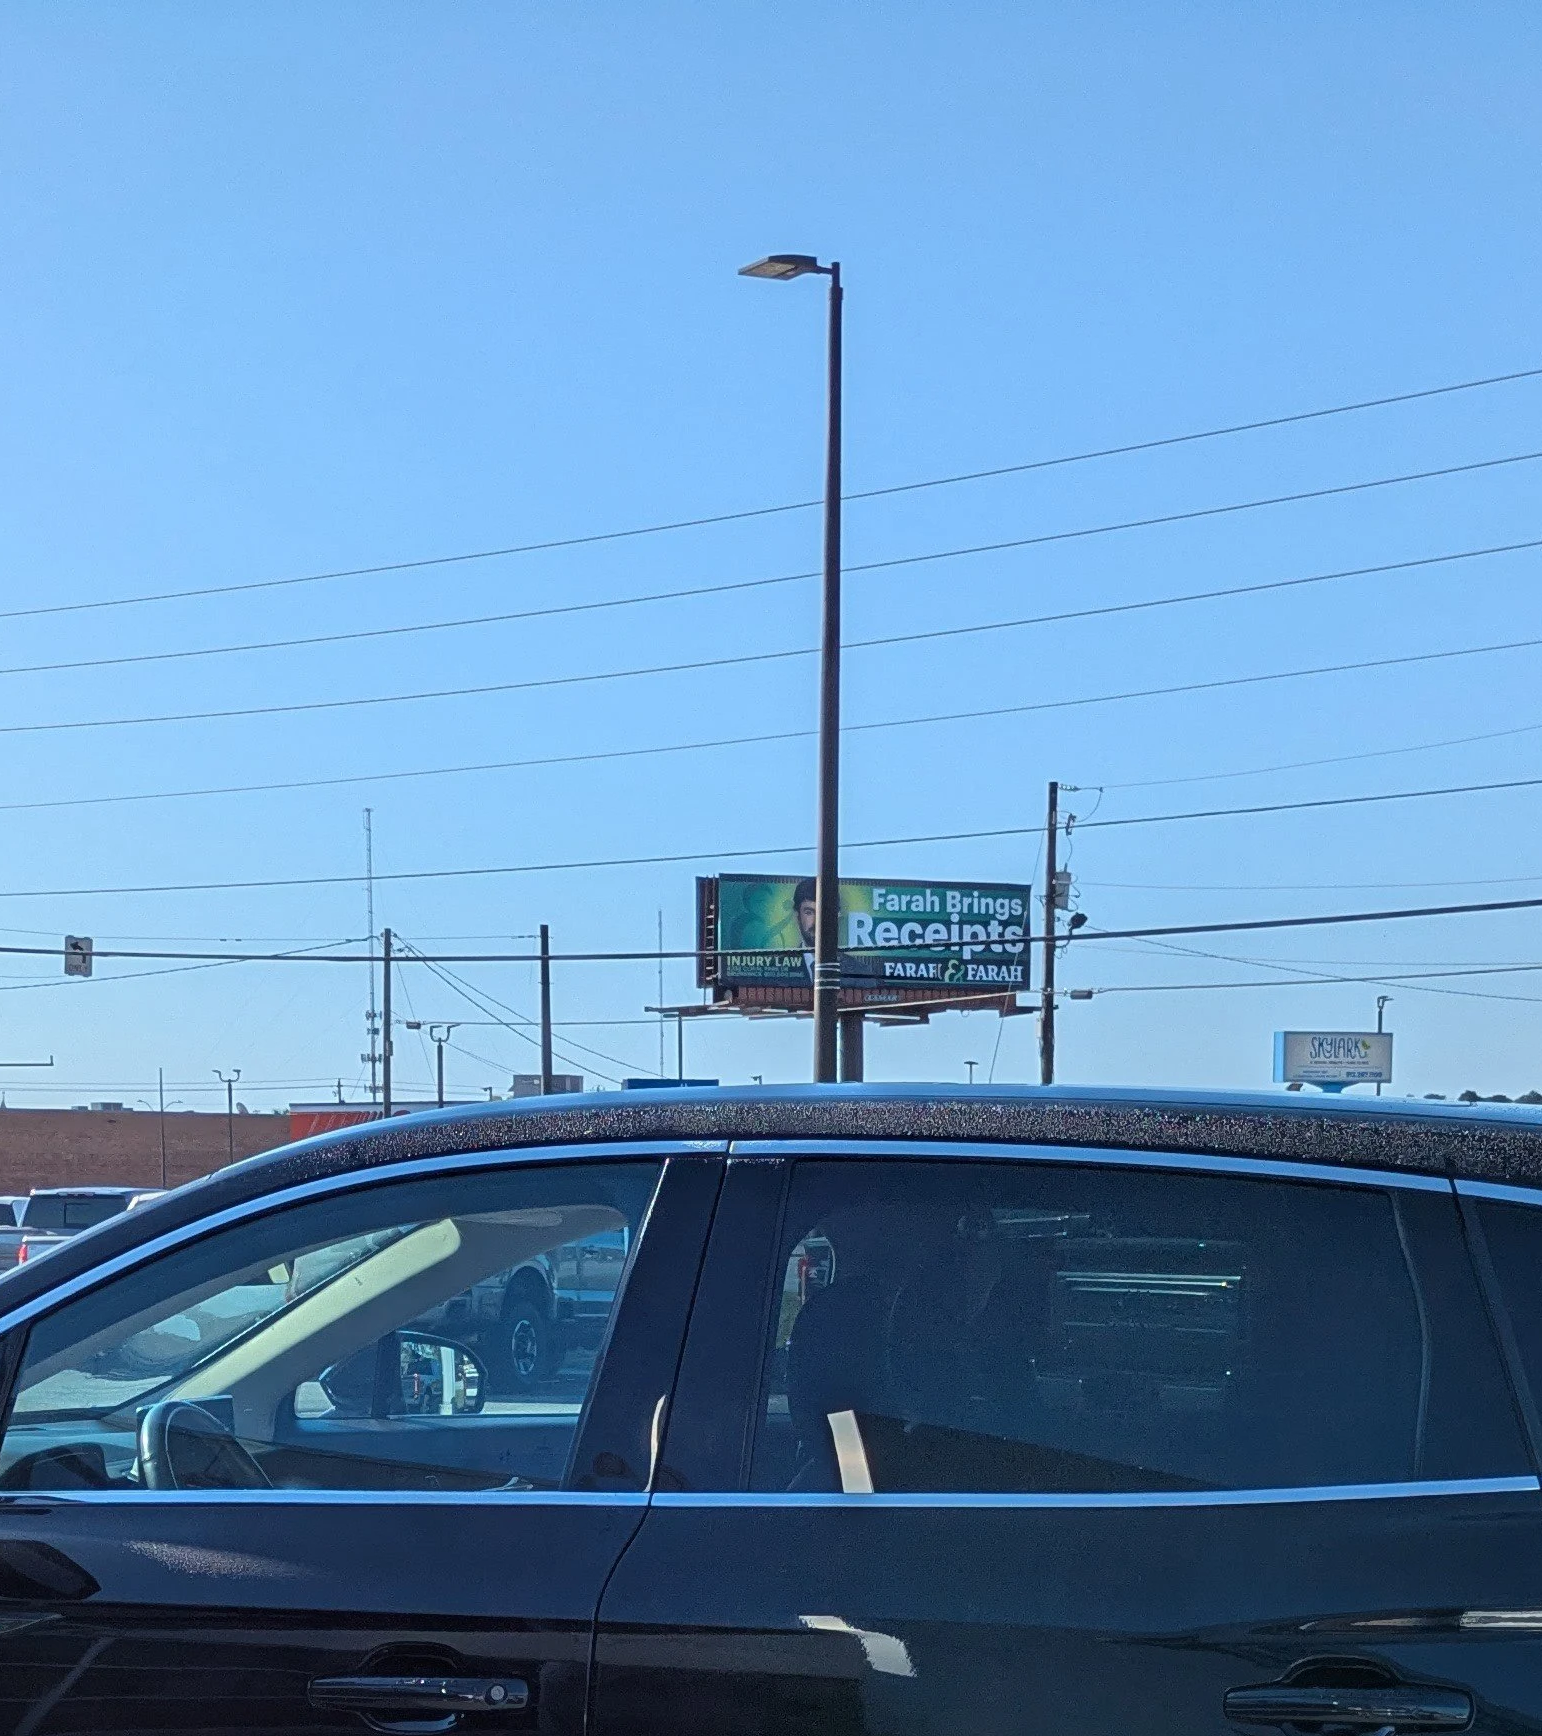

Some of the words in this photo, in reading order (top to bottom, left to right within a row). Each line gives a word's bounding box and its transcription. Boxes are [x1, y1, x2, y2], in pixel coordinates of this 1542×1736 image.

[872, 888, 940, 912] Farah
[945, 890, 1023, 920] Brings
[847, 912, 1025, 960] Receipts
[726, 955, 772, 967] INJURY
[775, 956, 802, 967] LAW
[884, 962, 942, 980] FARAH
[966, 964, 1023, 982] FARAH
[1310, 1036, 1367, 1060] SKYLARK
